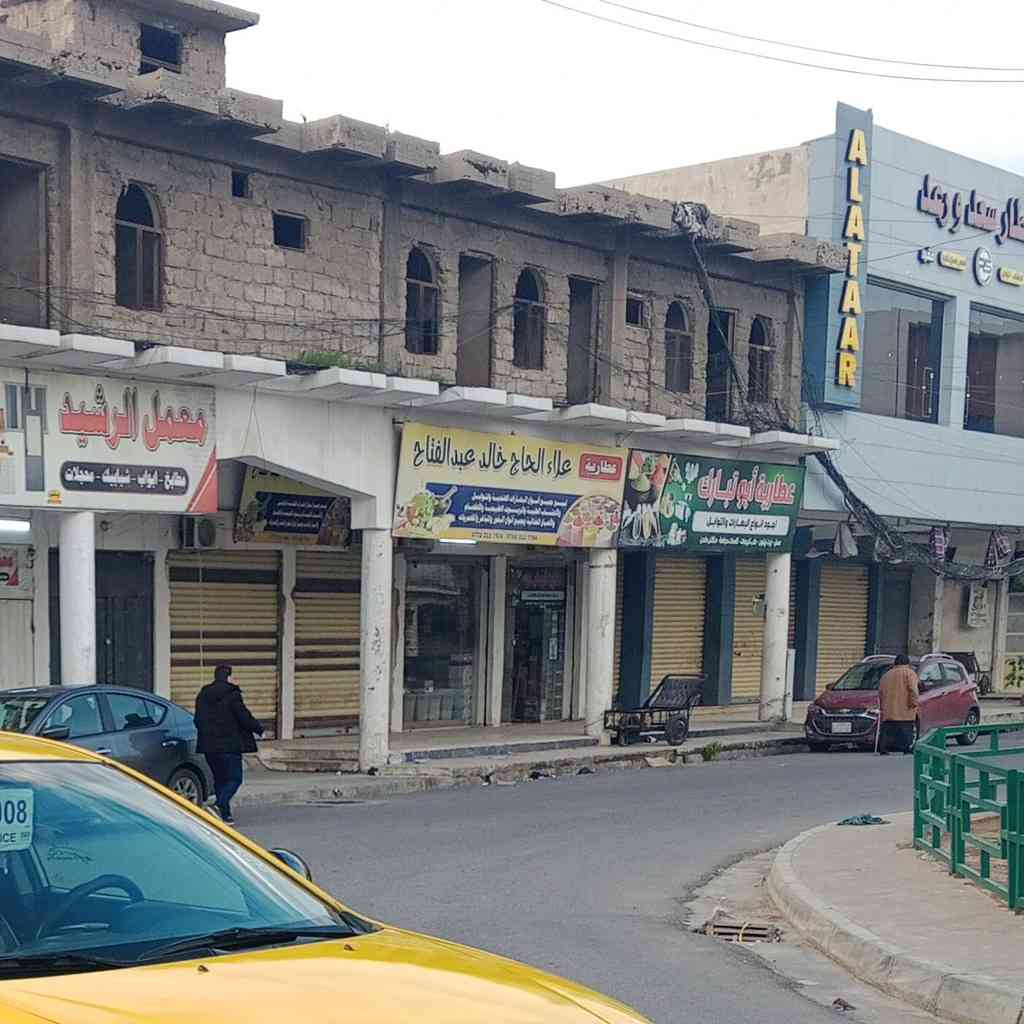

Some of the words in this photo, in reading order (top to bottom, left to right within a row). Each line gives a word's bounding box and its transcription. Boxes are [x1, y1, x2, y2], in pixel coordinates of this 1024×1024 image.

[58, 383, 139, 450] الرشيد
[143, 389, 209, 452] معمل
[479, 442, 507, 470] خالد
[510, 446, 545, 476] الحاج
[546, 449, 572, 478] علاء
[584, 456, 617, 476] عطارية
[755, 472, 797, 511] عطارية
